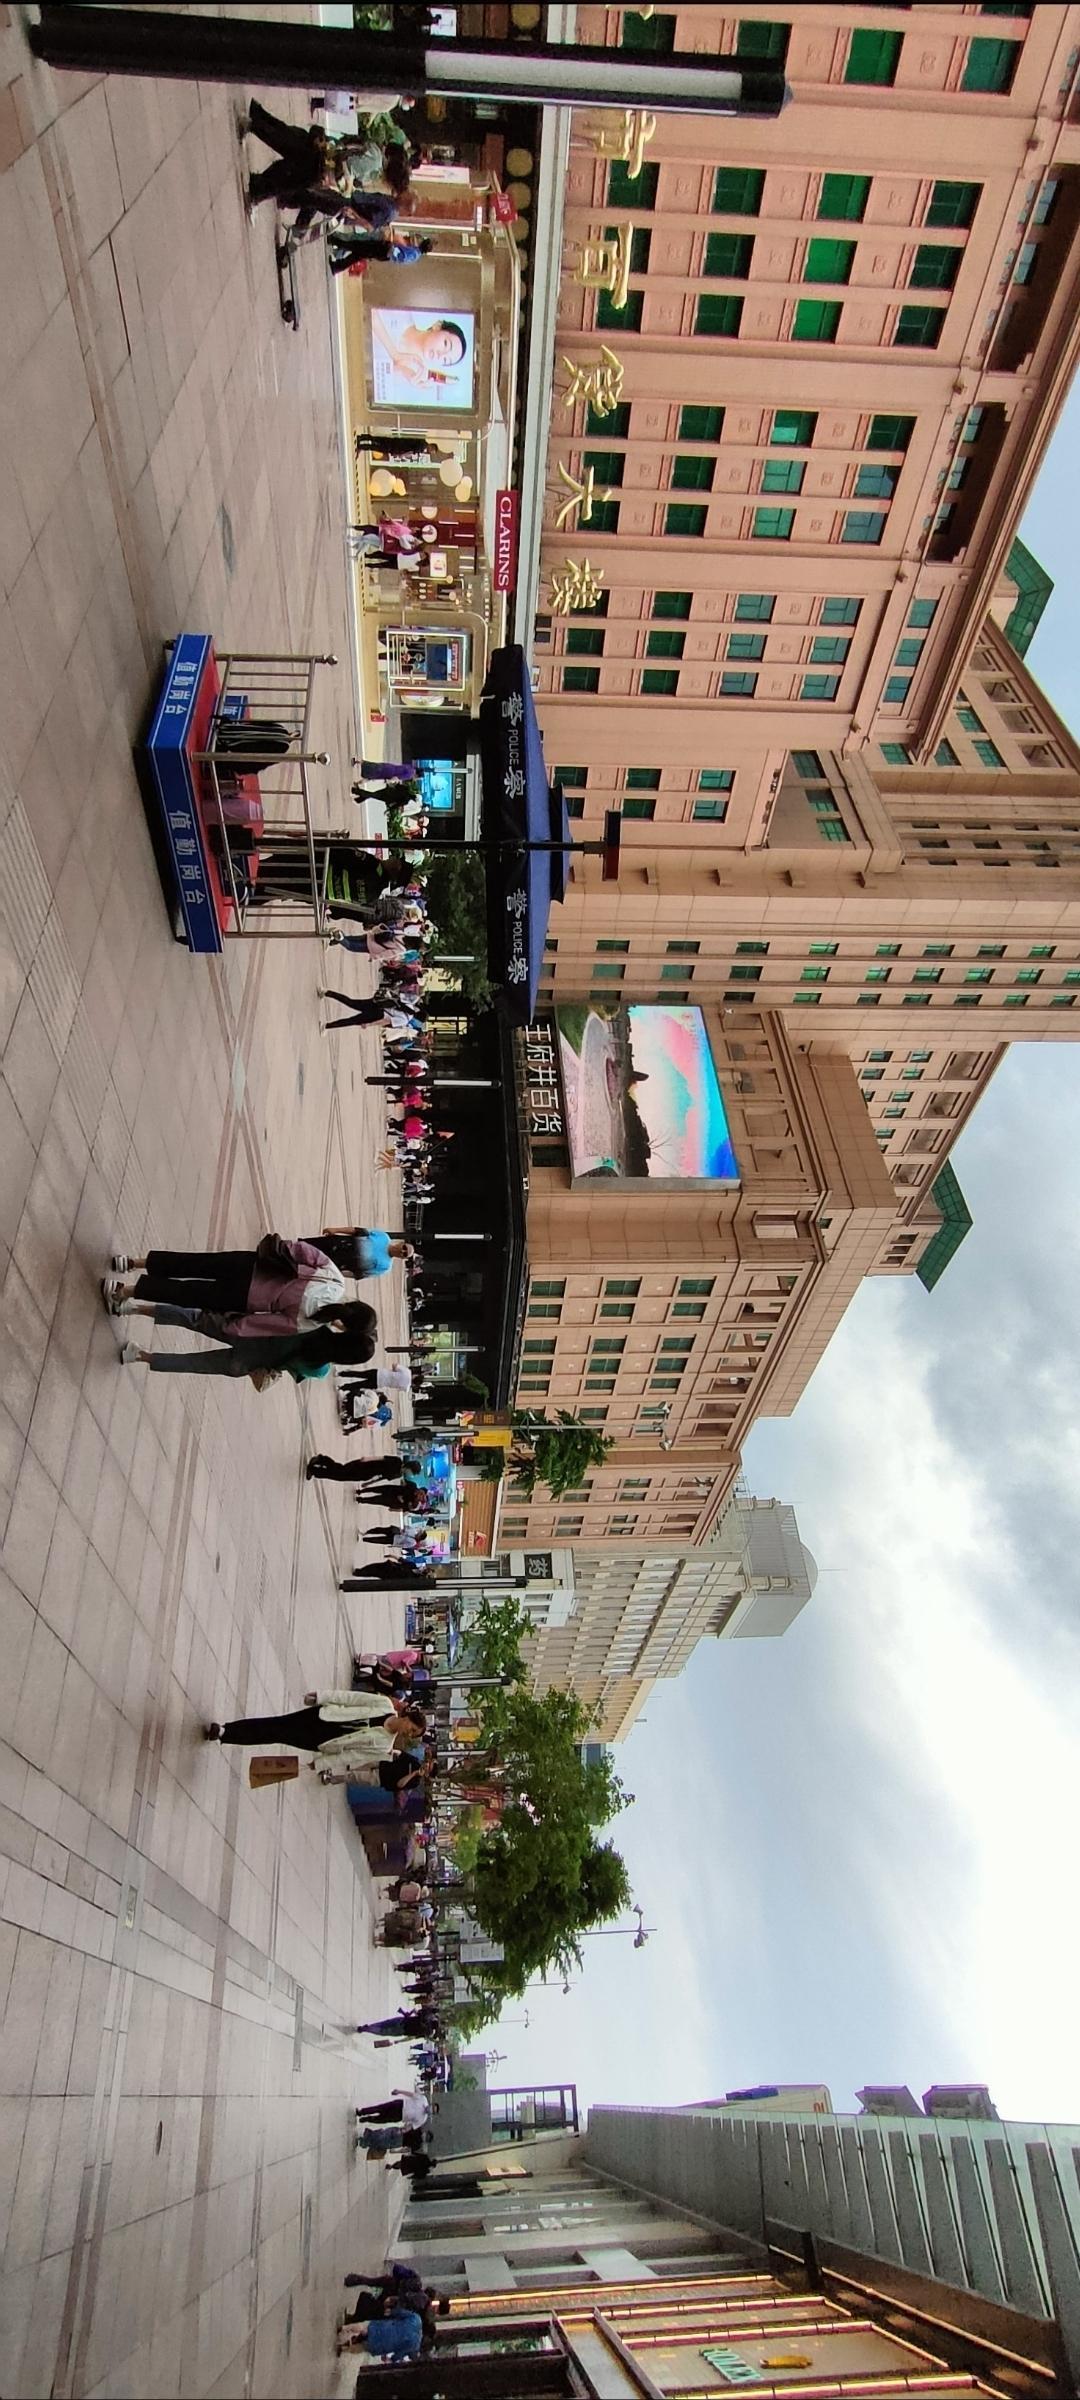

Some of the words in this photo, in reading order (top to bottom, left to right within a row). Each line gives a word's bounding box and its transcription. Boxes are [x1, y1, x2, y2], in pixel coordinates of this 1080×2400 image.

[498, 496, 512, 586] CLARINS
[163, 661, 198, 716] 值勤岗台
[501, 692, 524, 727] 警
[507, 729, 520, 765] POLICE
[503, 766, 526, 799] 察
[168, 810, 205, 905] 值勤岗台
[506, 888, 528, 918] 警
[512, 920, 523, 954] POLICE
[507, 954, 529, 985] 察
[525, 1024, 562, 1133] 王府井百货
[527, 1558, 550, 1578] 药
